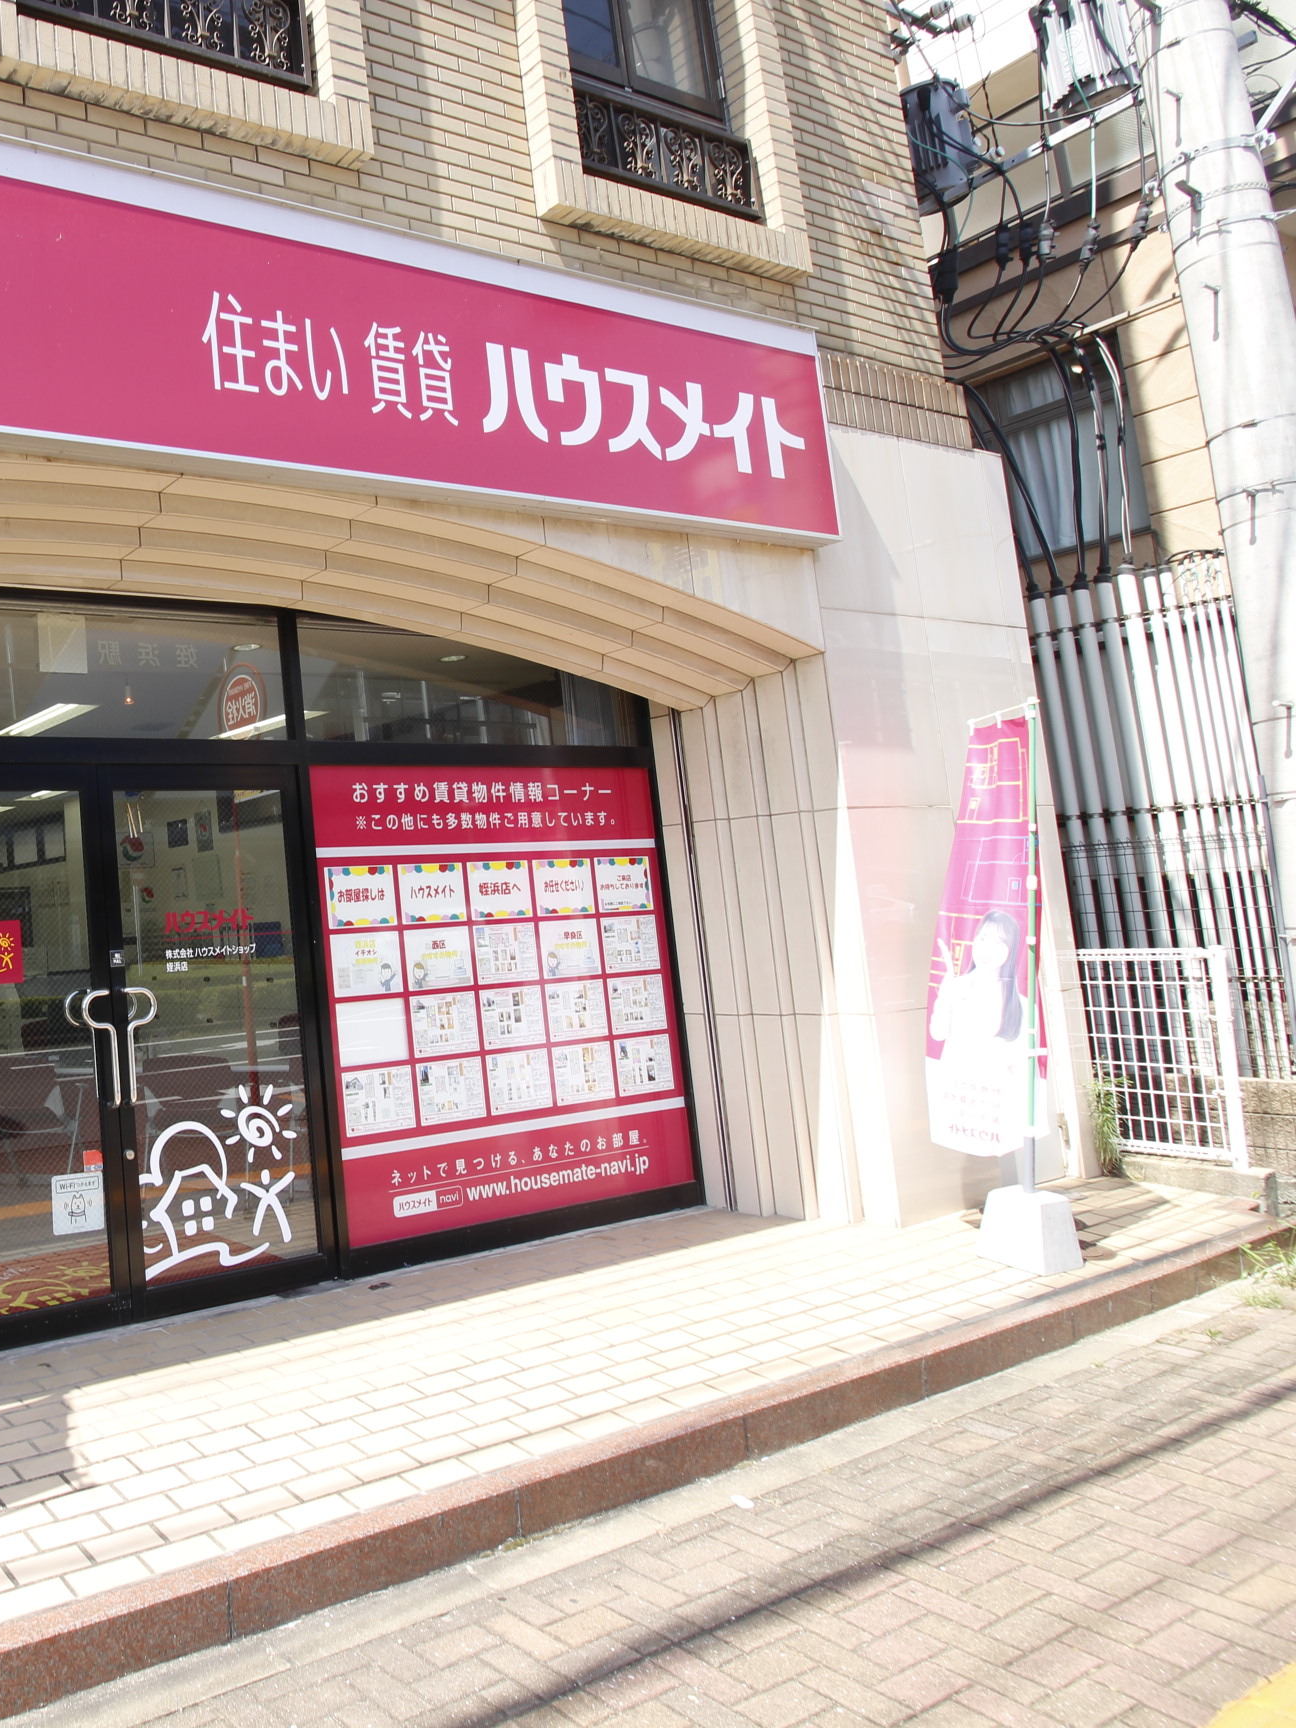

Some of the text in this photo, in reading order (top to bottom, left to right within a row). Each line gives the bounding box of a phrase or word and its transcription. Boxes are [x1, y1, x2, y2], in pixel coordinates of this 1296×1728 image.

[202, 290, 805, 480] 住まい 賃貸 ハウスメイト
[352, 781, 612, 803] おすすめ賃貸物件情報コーナー
[337, 887, 385, 904] お部屋探しは
[410, 884, 455, 899] ハウスメイト
[478, 881, 522, 896] 姪浜店へ
[164, 908, 256, 934] ハウスメイト
[165, 943, 256, 960] 株式会社 ハウスメイトショップ
[166, 961, 189, 973] 姪浜店
[391, 1129, 648, 1187] ネットで見つける、あなたのお部屋。
[398, 1153, 650, 1213] ハウスメイト navi www.housemate-navi.jp
